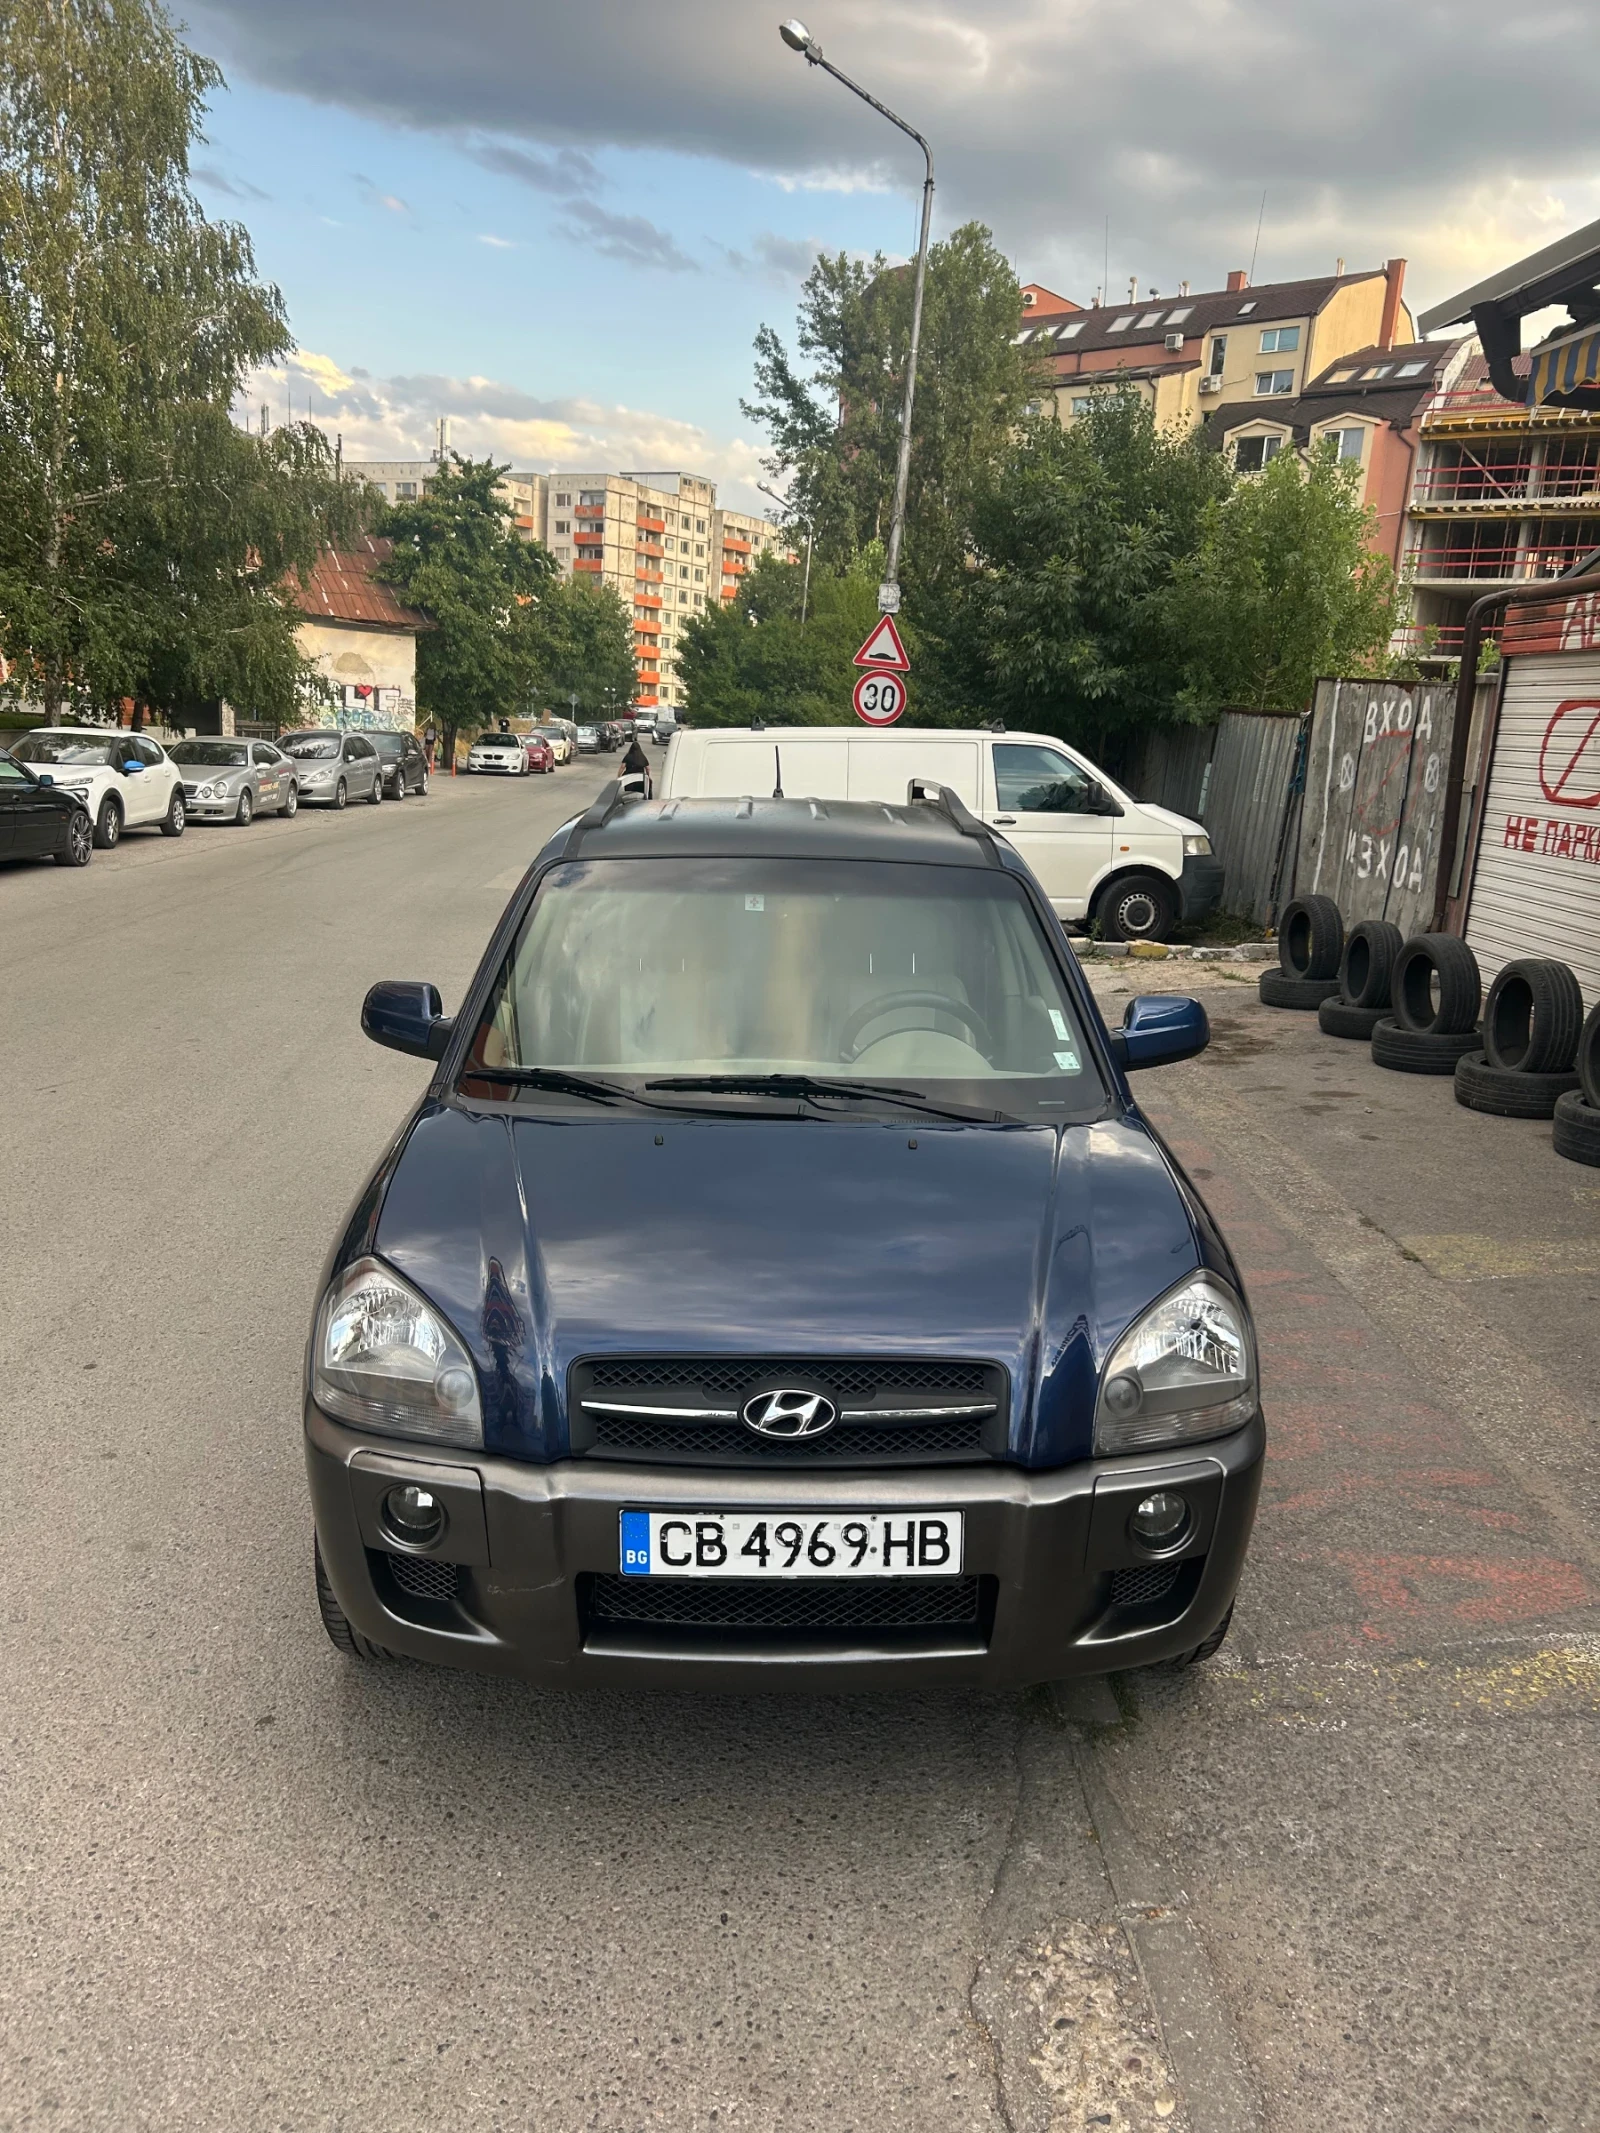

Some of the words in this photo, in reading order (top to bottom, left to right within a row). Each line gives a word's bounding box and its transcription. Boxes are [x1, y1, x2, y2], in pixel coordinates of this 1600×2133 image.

[864, 684, 895, 712] 30
[1504, 815, 1538, 852] НЕ
[626, 1549, 648, 1565] BG
[660, 1521, 728, 1567] CB
[741, 1522, 870, 1568] 4969
[883, 1520, 951, 1567] HB
